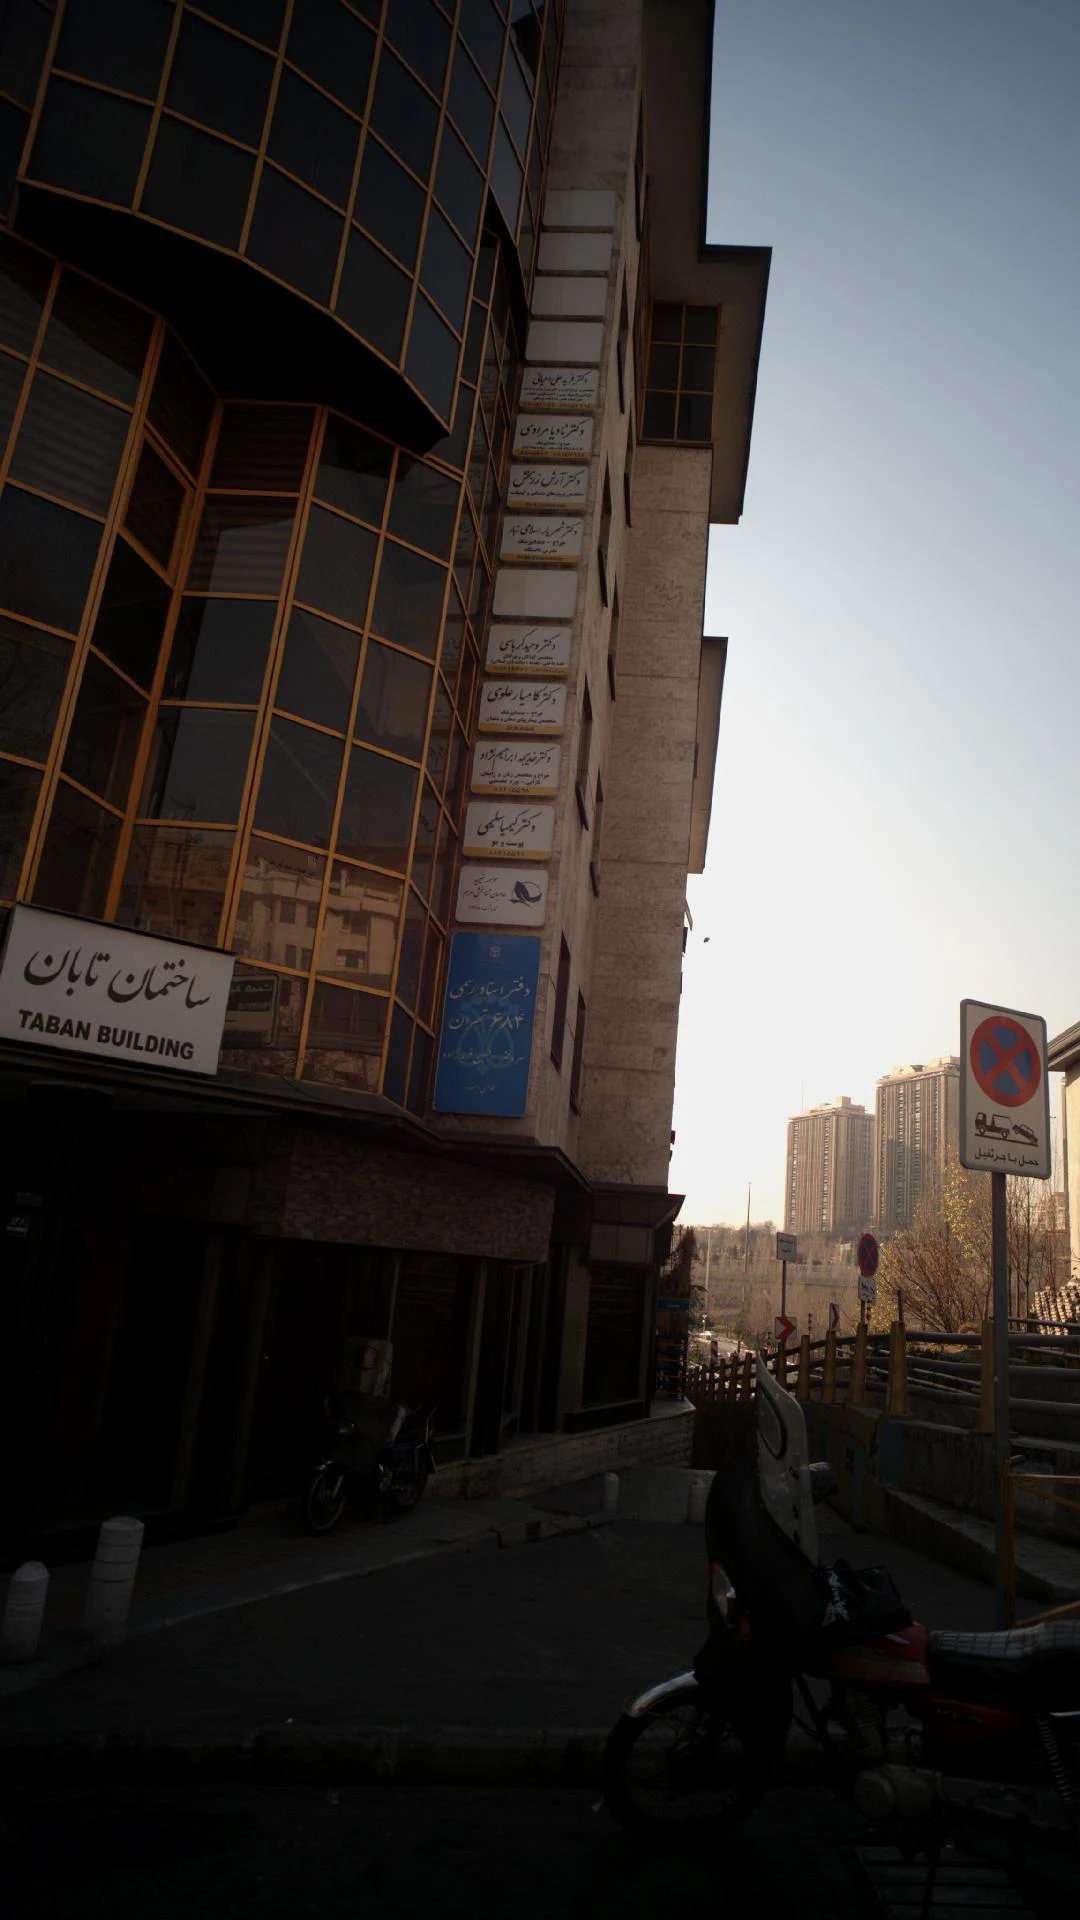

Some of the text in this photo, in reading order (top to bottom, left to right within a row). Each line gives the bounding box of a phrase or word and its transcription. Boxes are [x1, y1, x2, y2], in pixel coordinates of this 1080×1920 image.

[519, 423, 549, 437] مرادی
[562, 418, 591, 439] دکتر
[541, 470, 568, 487] آرش
[562, 469, 585, 488] دکتر
[560, 520, 583, 538] دکتر
[538, 633, 561, 652] دکتر
[486, 686, 513, 703] علوی
[536, 687, 561, 708] دکتر
[517, 751, 537, 766] خدیجه
[532, 746, 557, 766] دکتر
[476, 808, 543, 836] دکتر کیمیا سلیمی
[505, 839, 525, 848] پوست
[23, 945, 211, 1010] ساختمان تابان
[449, 976, 531, 1000] دفتر اسناد رسمی
[448, 1008, 489, 1031] تهران
[18, 1008, 195, 1060] TABAN BUILDING
[974, 1147, 1040, 1168] حمل با جرثقیل
